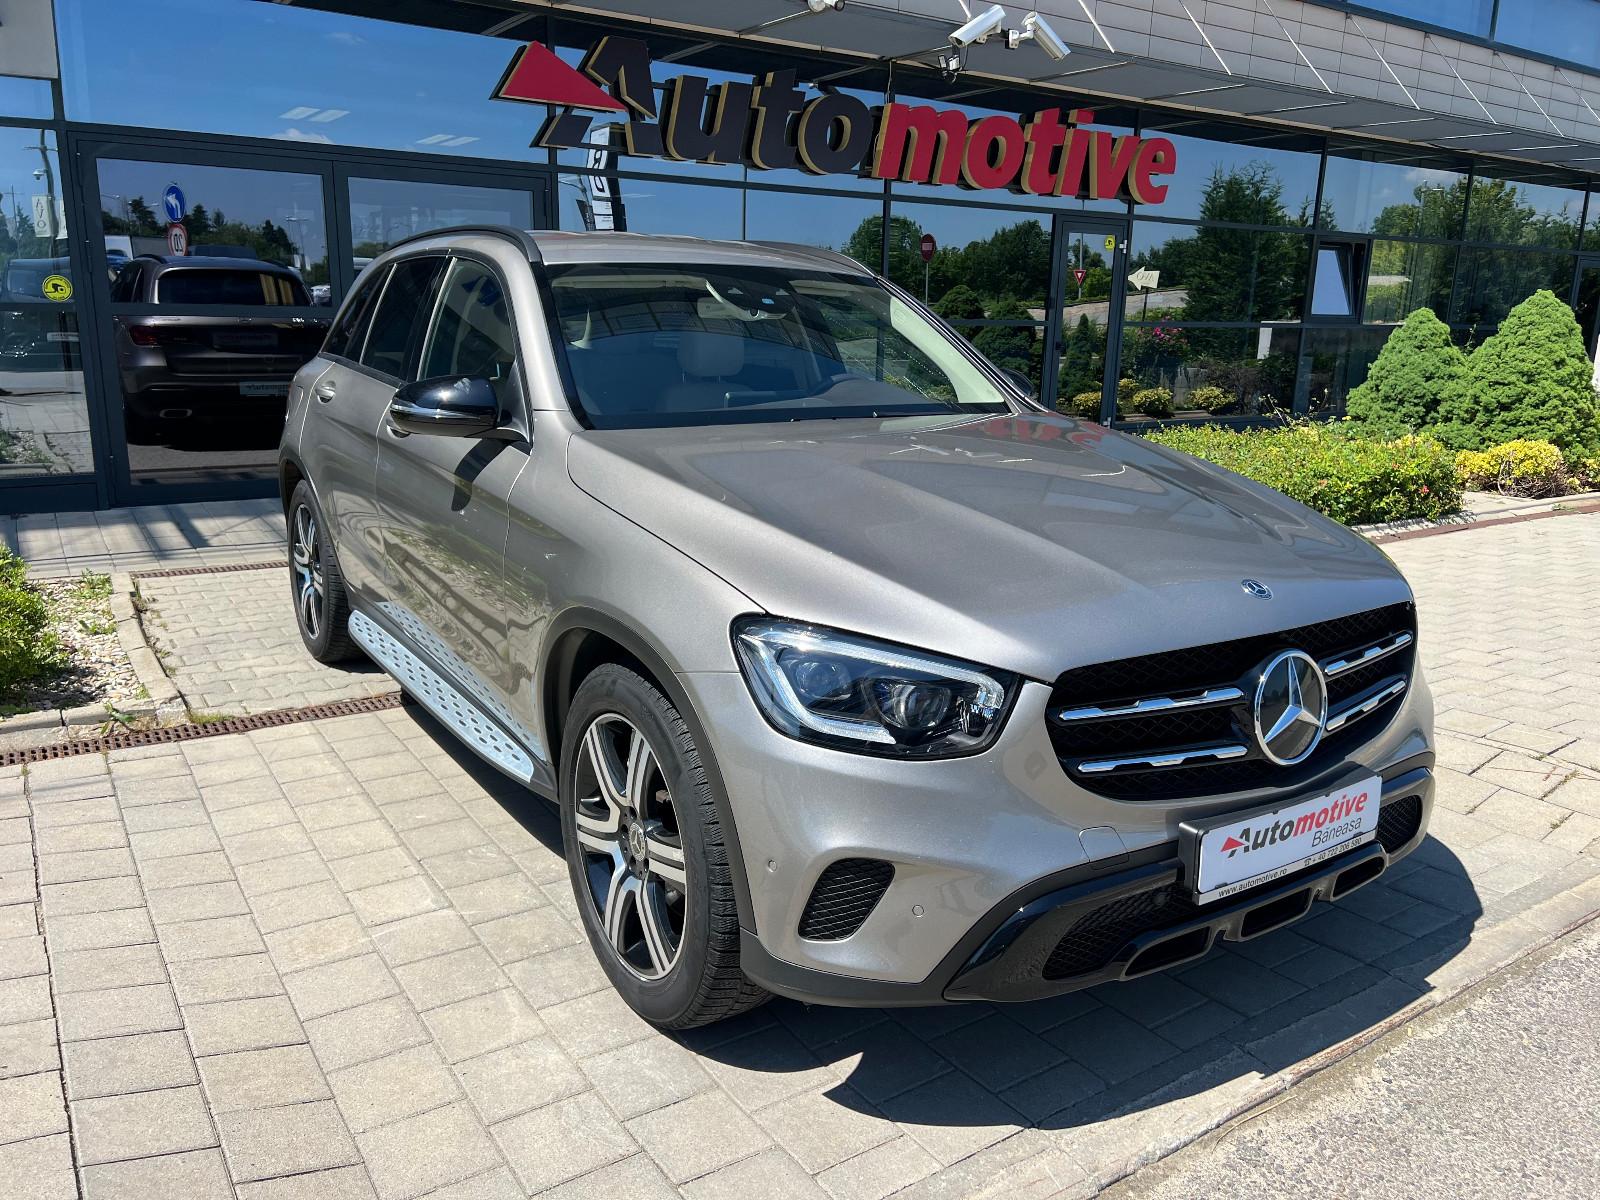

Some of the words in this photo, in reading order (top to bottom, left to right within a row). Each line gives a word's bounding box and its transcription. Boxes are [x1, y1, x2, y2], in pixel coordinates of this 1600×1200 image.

[492, 35, 1177, 205] Automotive
[1220, 792, 1368, 858] Automotive
[1218, 868, 1288, 897] www.automotive.ro
